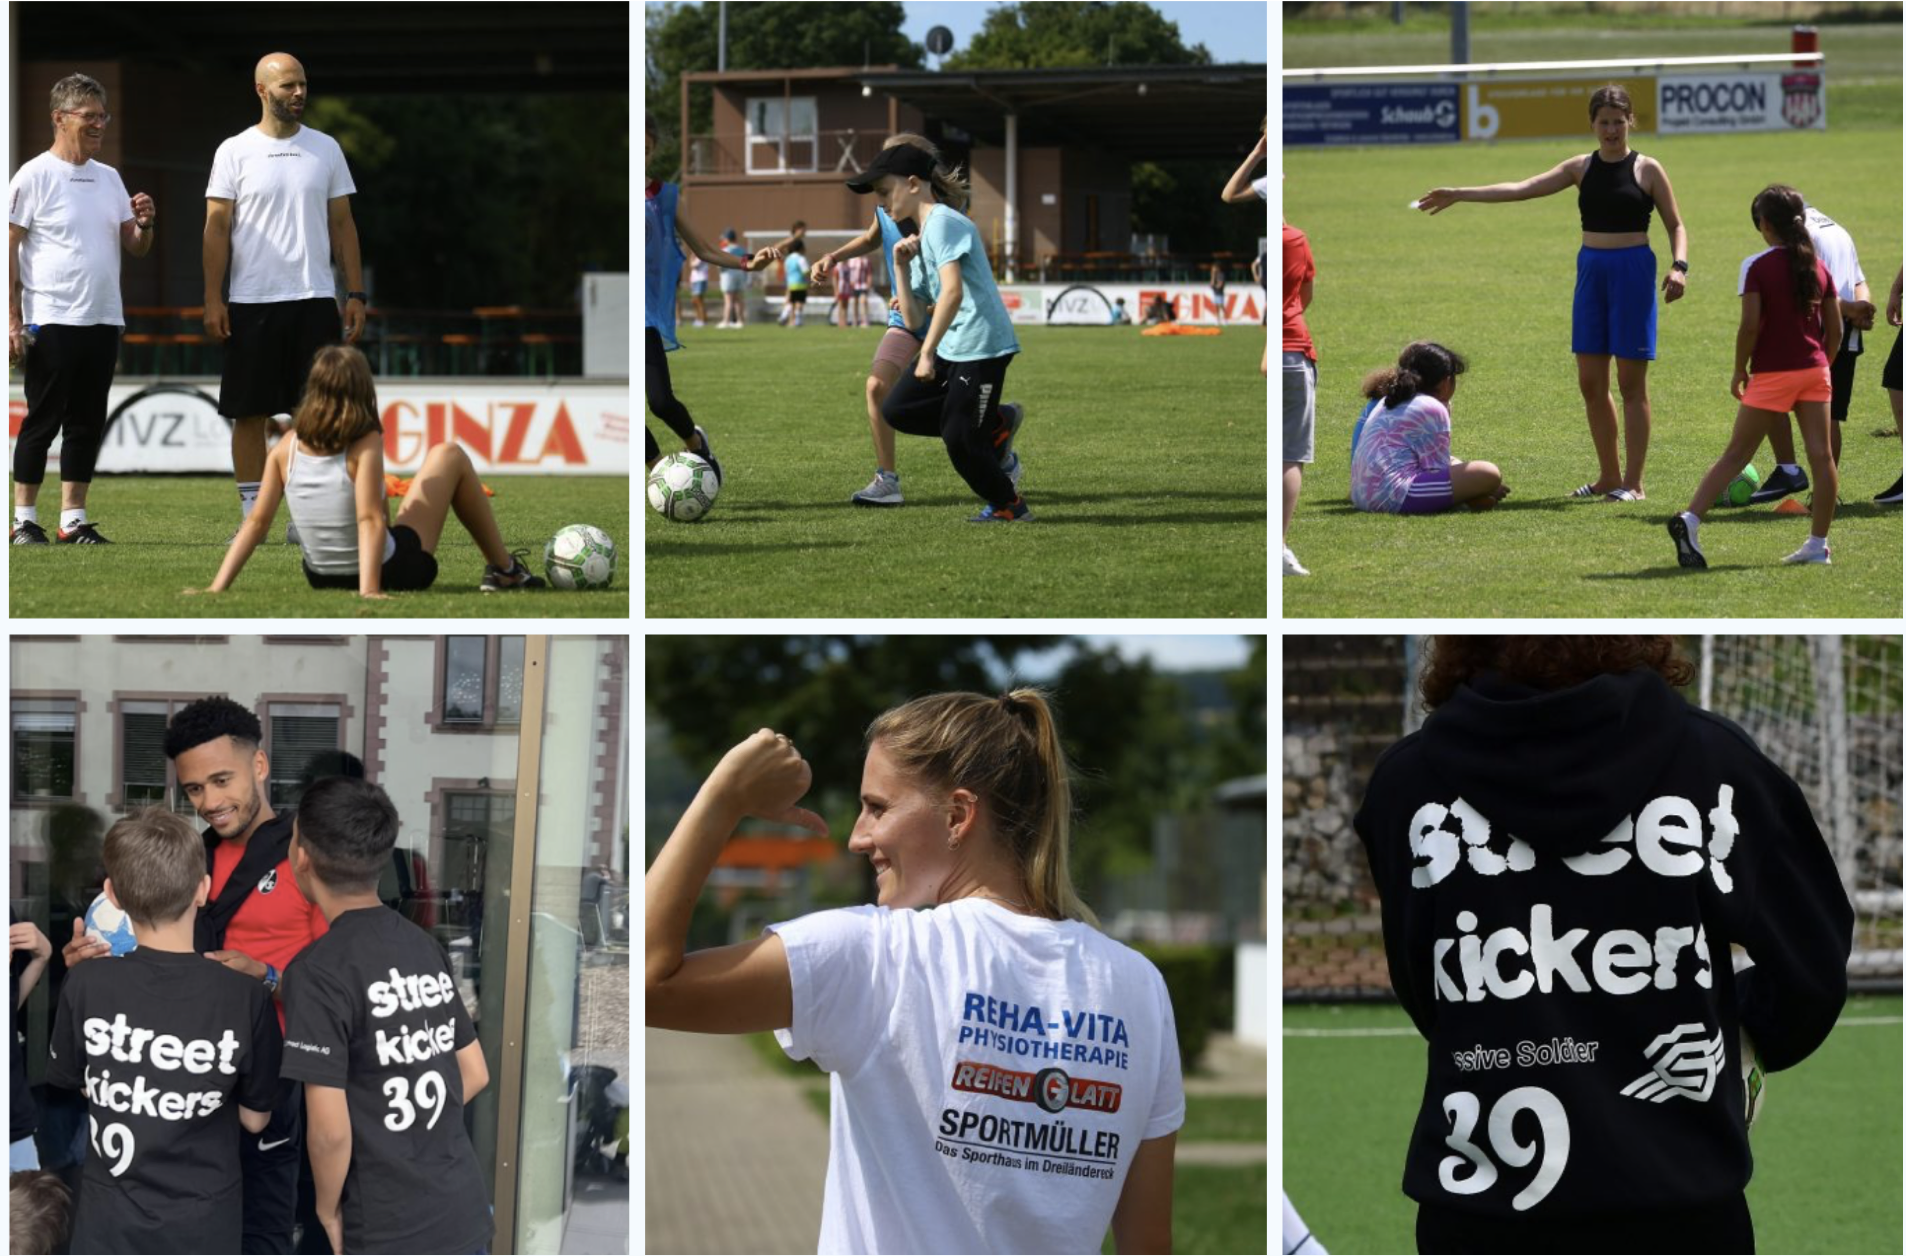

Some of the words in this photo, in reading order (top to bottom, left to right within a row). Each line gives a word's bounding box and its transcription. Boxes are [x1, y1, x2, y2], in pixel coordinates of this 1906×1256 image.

[1380, 104, 1434, 124] Schaub
[1467, 83, 1501, 138] b
[1661, 82, 1766, 114] PROCON
[383, 398, 589, 465] GINZA
[83, 1013, 240, 1075] street
[963, 992, 1129, 1048] REHA-VITA
[958, 1025, 1129, 1071] PHYSIOTHERAPIE
[1516, 1037, 1599, 1067] Soldier
[84, 1064, 223, 1121] kickers
[383, 1070, 447, 1132] 39
[955, 1065, 1031, 1098] REIFEN
[935, 1140, 958, 1157] Das
[961, 1147, 1022, 1169] Sporthaus
[1024, 1157, 1040, 1172] im
[1042, 1159, 1114, 1180] Dreiländereck
[939, 1108, 1121, 1160] SPORTMÜLLER
[1438, 1086, 1570, 1211] 39
